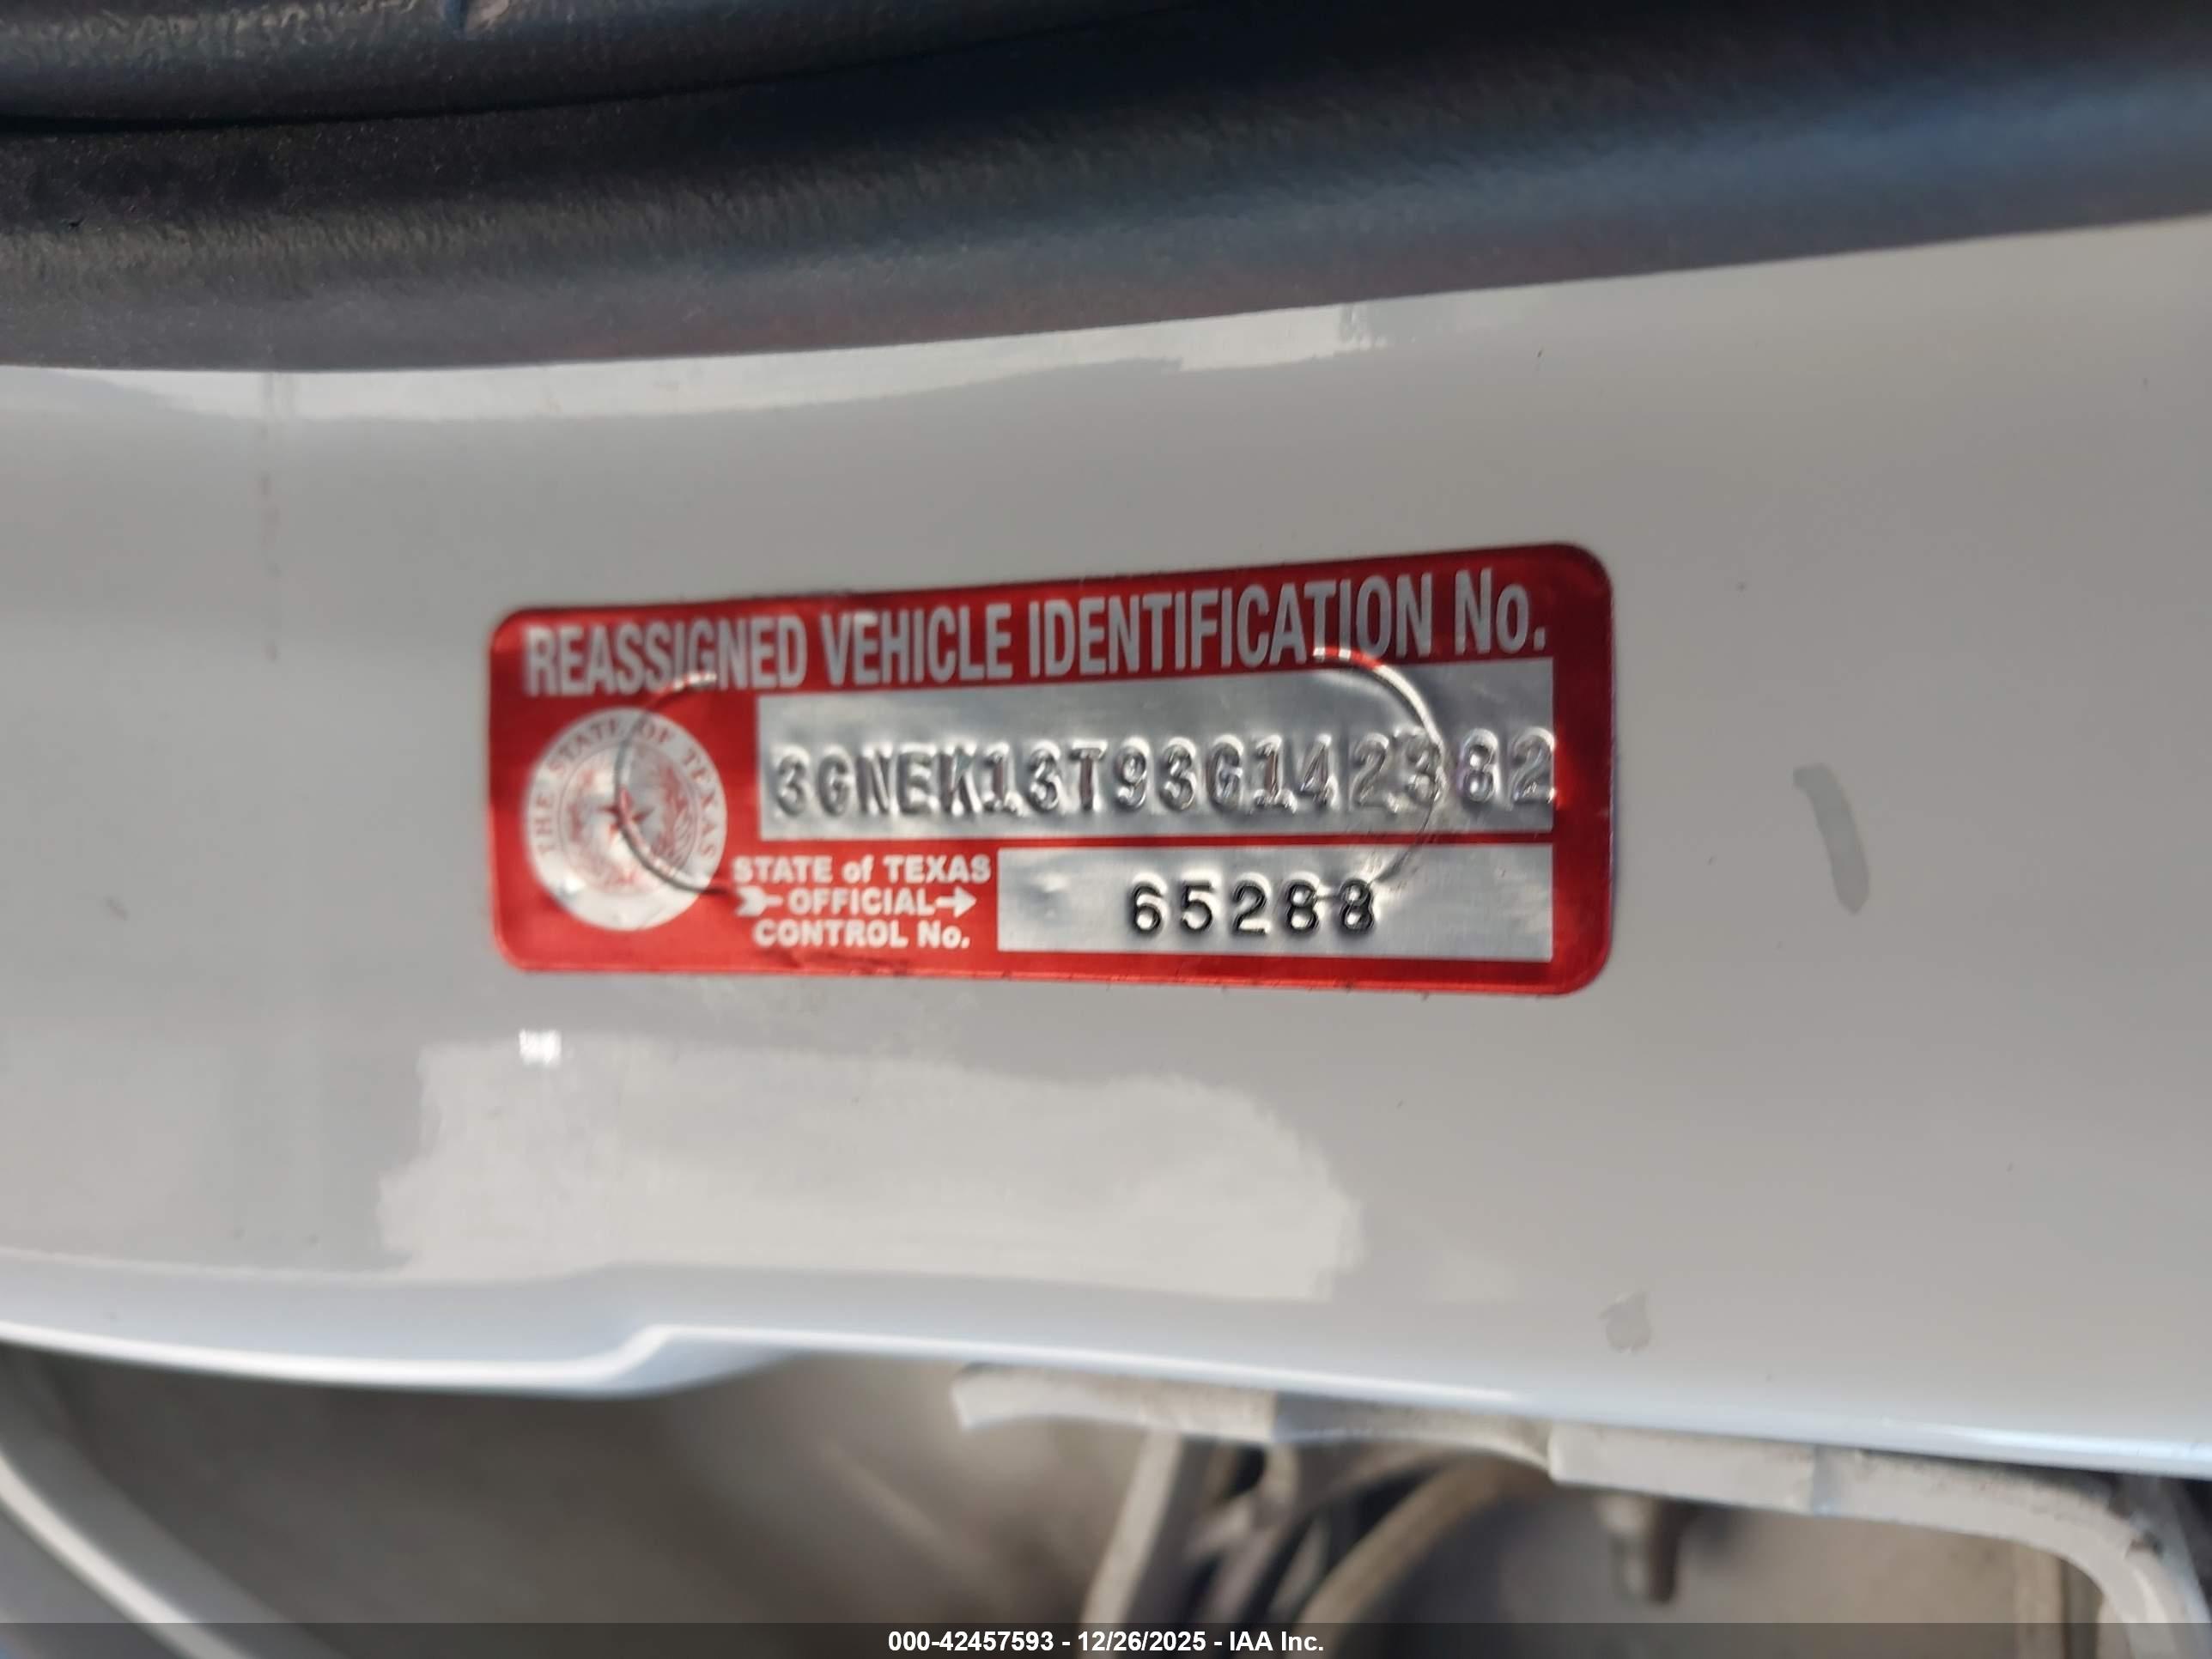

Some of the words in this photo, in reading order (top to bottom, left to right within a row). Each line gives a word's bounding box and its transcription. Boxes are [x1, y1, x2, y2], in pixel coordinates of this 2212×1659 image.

[526, 616, 808, 696] REASSIGNED
[819, 603, 1013, 687] VEHICLE
[1029, 573, 1433, 678] IDENTIFICATION
[1454, 568, 1548, 654] No.
[773, 728, 1556, 816] 3GNEK13T93G142382
[732, 854, 834, 884] STATE
[841, 854, 874, 884] of
[882, 854, 992, 884] TEXAS
[787, 886, 937, 915] OFFICIAL
[1131, 872, 1376, 934] 65288
[753, 918, 908, 948] CONTROL
[916, 919, 971, 950] No.
